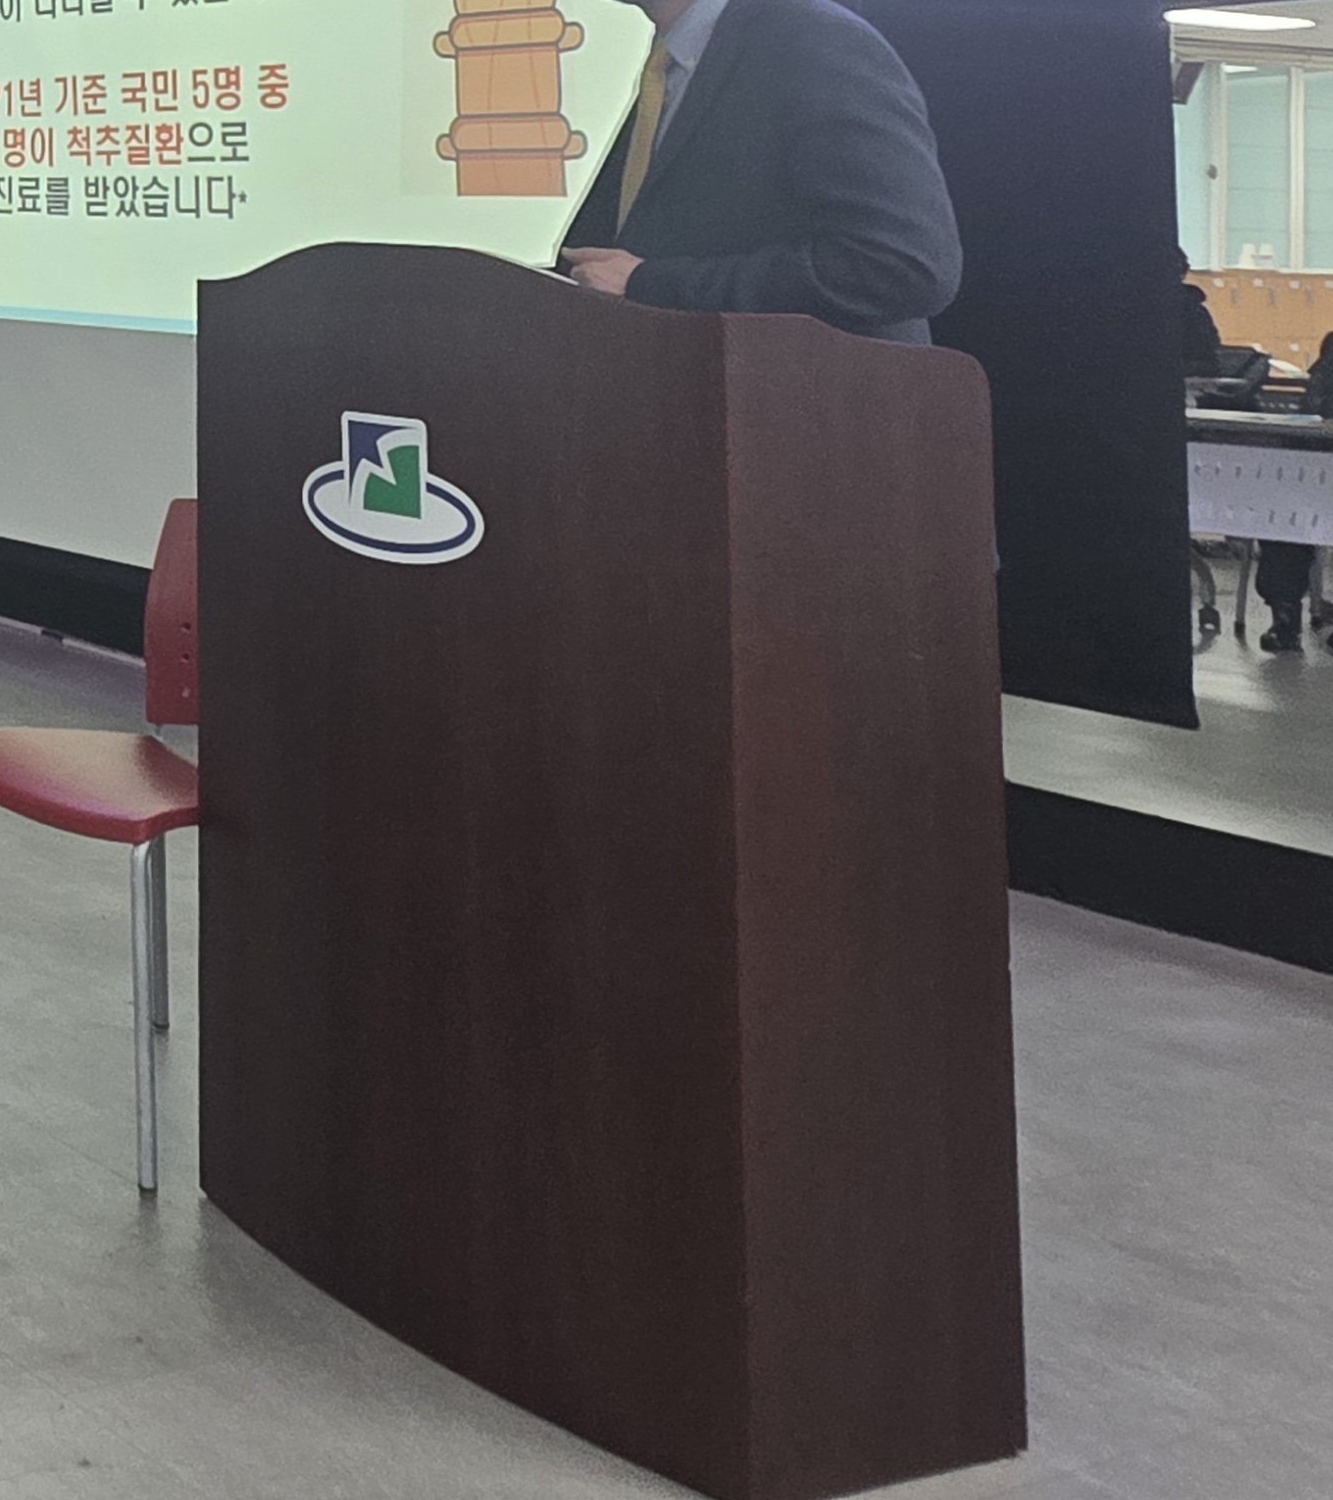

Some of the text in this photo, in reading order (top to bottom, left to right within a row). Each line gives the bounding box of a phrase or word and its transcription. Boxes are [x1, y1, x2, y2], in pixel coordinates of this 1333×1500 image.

[54, 73, 108, 116] 기준
[121, 68, 178, 113] 국민
[191, 65, 241, 111] 5명
[257, 63, 289, 109] 중
[66, 121, 250, 167] 척추질환으로
